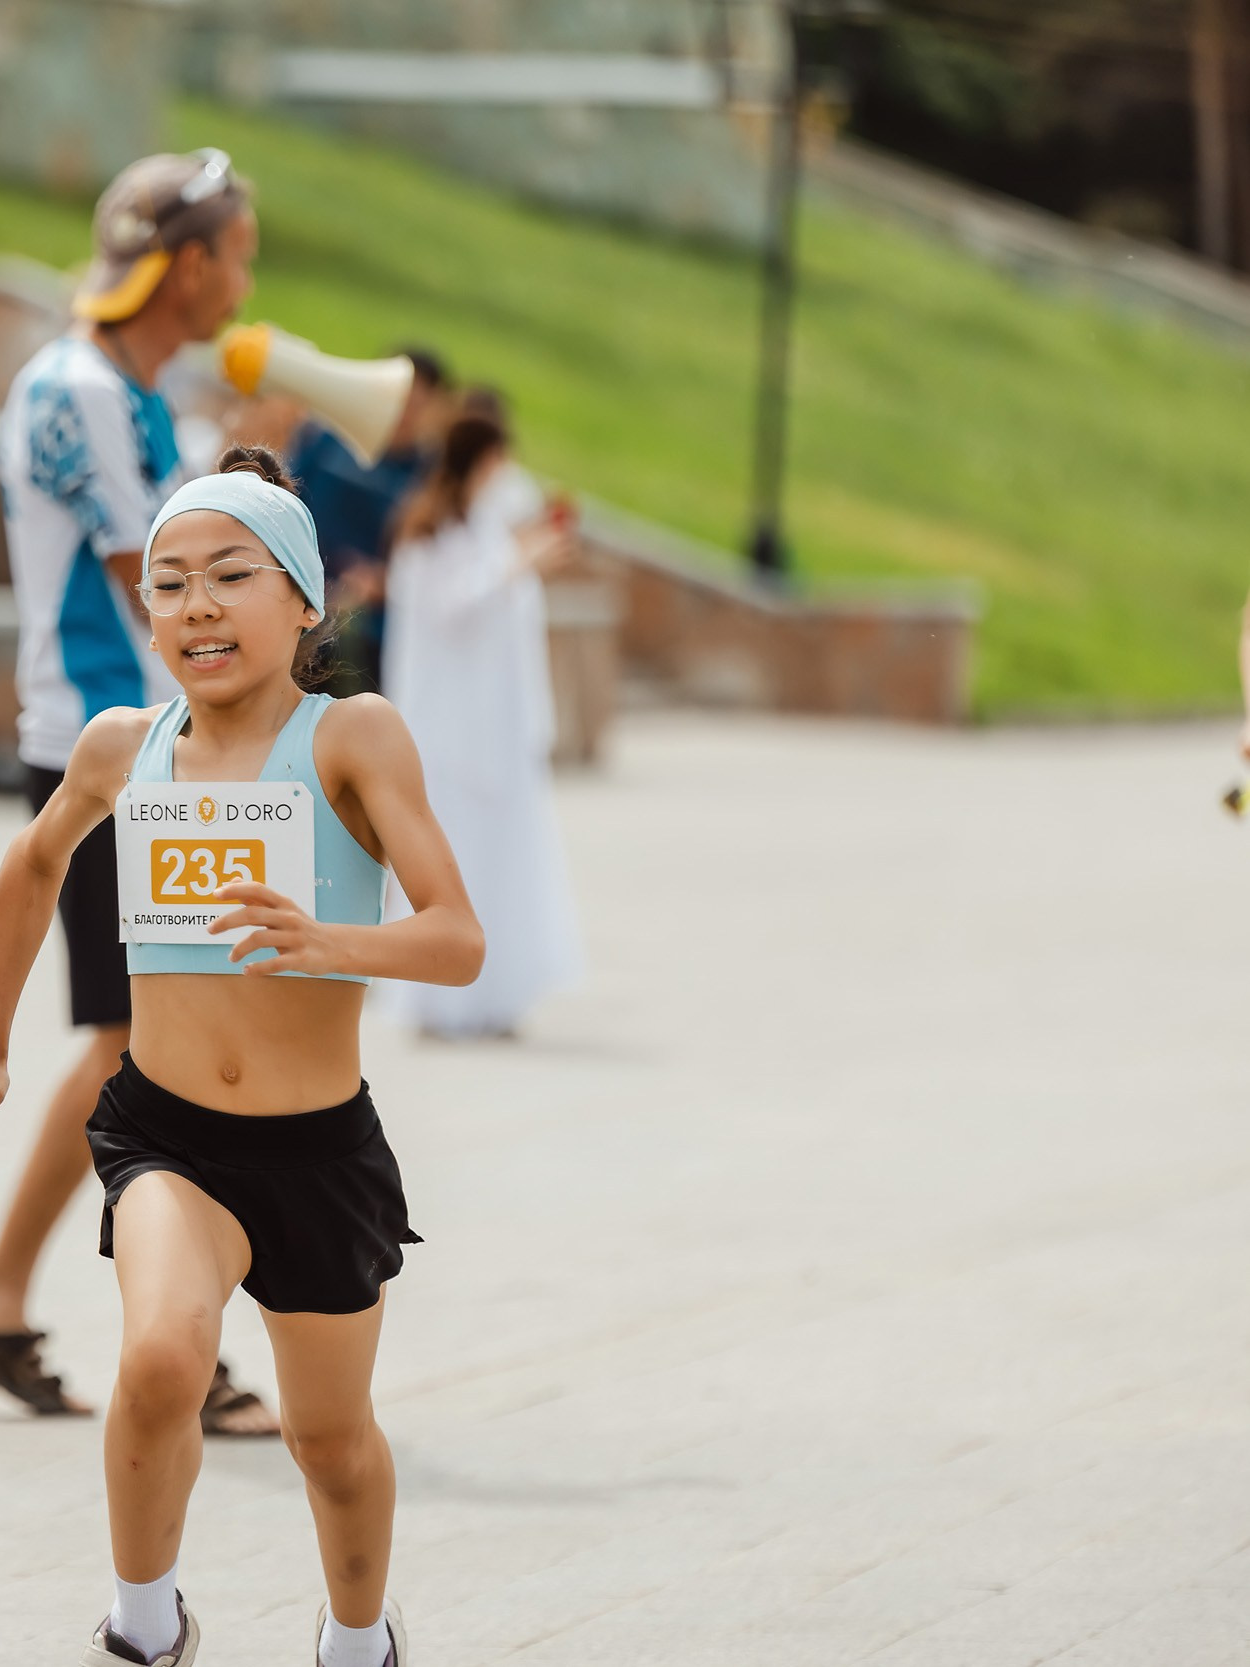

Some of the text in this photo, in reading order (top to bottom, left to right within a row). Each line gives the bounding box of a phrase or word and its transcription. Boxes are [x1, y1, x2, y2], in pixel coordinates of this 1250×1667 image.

[130, 803, 292, 821] LEONE D'ORO
[160, 847, 253, 896] 235
[134, 914, 220, 926] БЛАГОТВОРИТЕЛ
